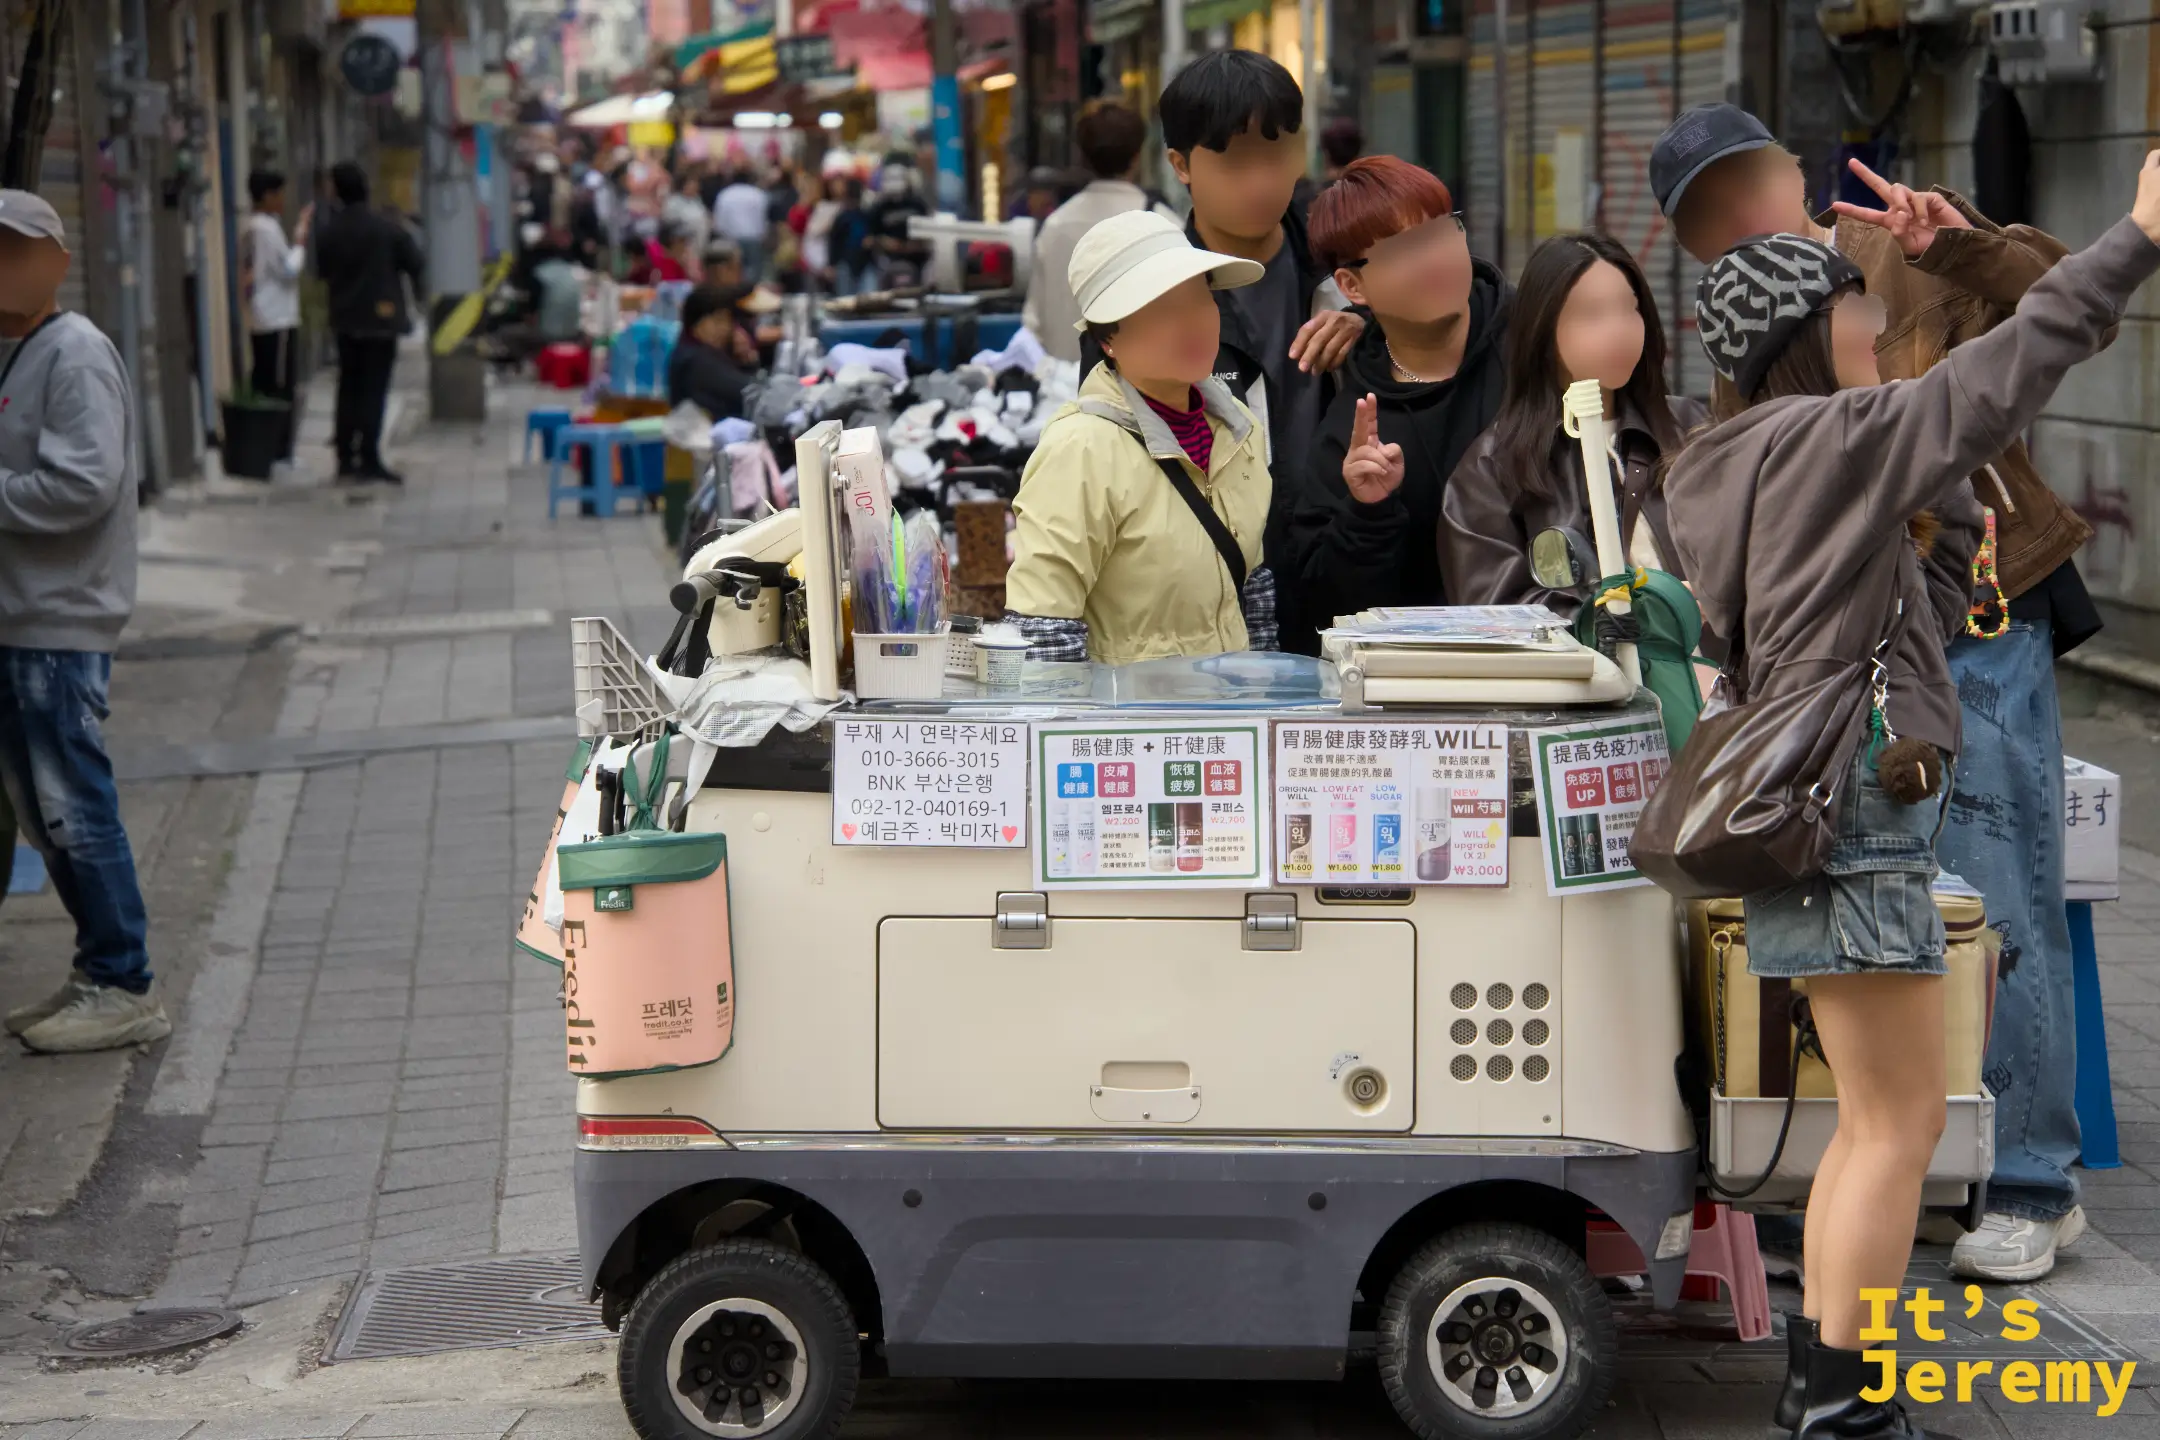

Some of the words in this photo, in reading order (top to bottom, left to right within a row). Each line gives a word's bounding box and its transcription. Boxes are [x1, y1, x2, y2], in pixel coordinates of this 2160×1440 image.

[844, 724, 882, 744] 부재
[892, 724, 909, 744] 시
[920, 724, 1018, 745] 연락주세요
[1283, 730, 1431, 749] 胃腸健康發酵乳
[1435, 730, 1502, 749] WILL
[1072, 737, 1134, 757] 腸健康
[1164, 735, 1226, 755] 肝健康
[862, 750, 1000, 768] 010-3666-3015
[1304, 754, 1377, 764] 改善胃腸不適感
[1070, 765, 1082, 778] 腸
[1104, 765, 1129, 777] 皮膚
[1170, 763, 1195, 776] 恢復
[1210, 762, 1236, 775] 血液
[1288, 767, 1392, 778] 促進胃腸健康的乳酸菌
[1613, 765, 1635, 780] 恢復
[868, 774, 906, 791] BNK
[914, 774, 992, 794] 부산은행
[1566, 771, 1602, 786] 免疫力
[1063, 782, 1089, 794] 健康
[1104, 781, 1130, 794] 健康
[1170, 780, 1195, 792] 疲勞
[1210, 779, 1236, 792] 循環
[1376, 784, 1396, 792] LOW
[1615, 783, 1637, 798] 疲勞
[1576, 789, 1596, 802] UP
[852, 799, 1006, 816] 092-12-040169-1
[1102, 804, 1143, 815] 엠프로4
[1211, 802, 1244, 813] 쿠퍼스
[1453, 804, 1474, 814] Will
[1477, 801, 1502, 814] 芍藥
[2066, 788, 2112, 826] ます
[862, 821, 920, 841] 예금주
[940, 822, 999, 842] 박미자
[1454, 842, 1496, 850] upgrade
[601, 899, 625, 908] Fredit
[564, 919, 596, 1070] Fredit
[641, 996, 693, 1019] 프레딧
[644, 1018, 693, 1028] fredit.co.kr
